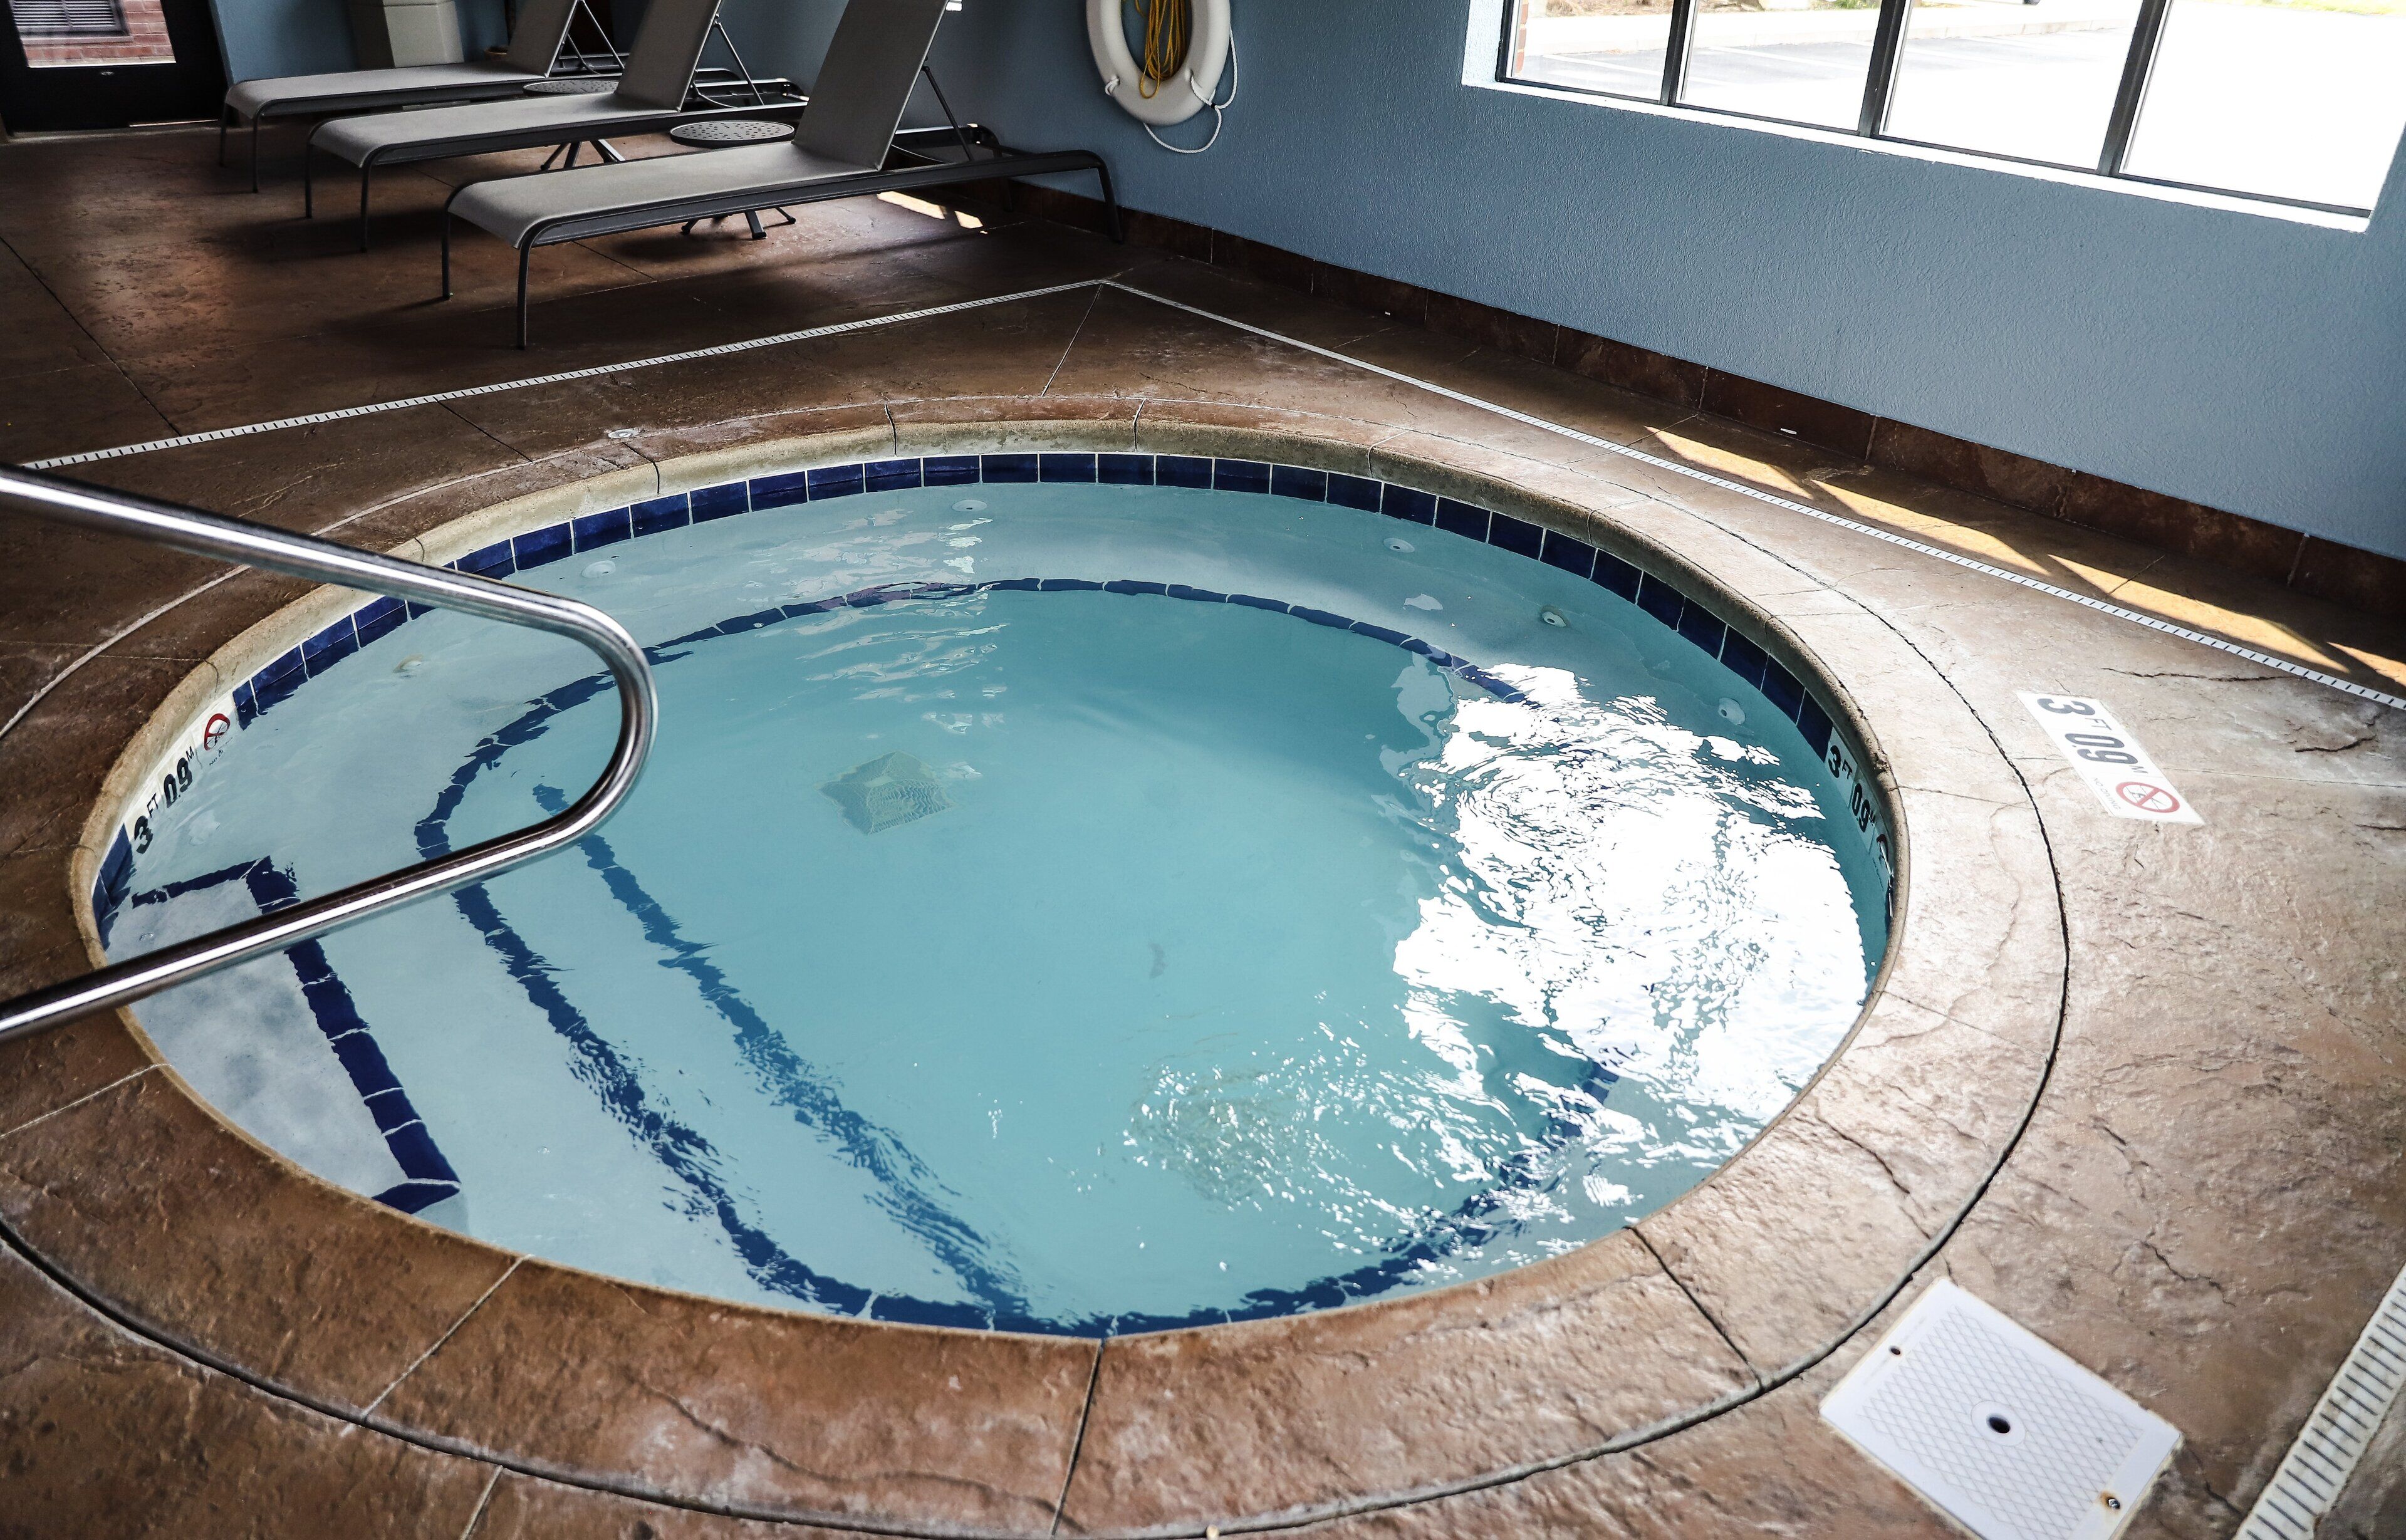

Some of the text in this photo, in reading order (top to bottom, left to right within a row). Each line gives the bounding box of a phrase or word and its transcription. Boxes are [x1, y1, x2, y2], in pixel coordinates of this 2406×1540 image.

[1828, 745, 1841, 778] 3
[2037, 698, 2096, 715] 3
[2085, 717, 2112, 731] FT
[2129, 765, 2148, 774] M
[134, 816, 154, 854] 3
[146, 793, 159, 818] FT
